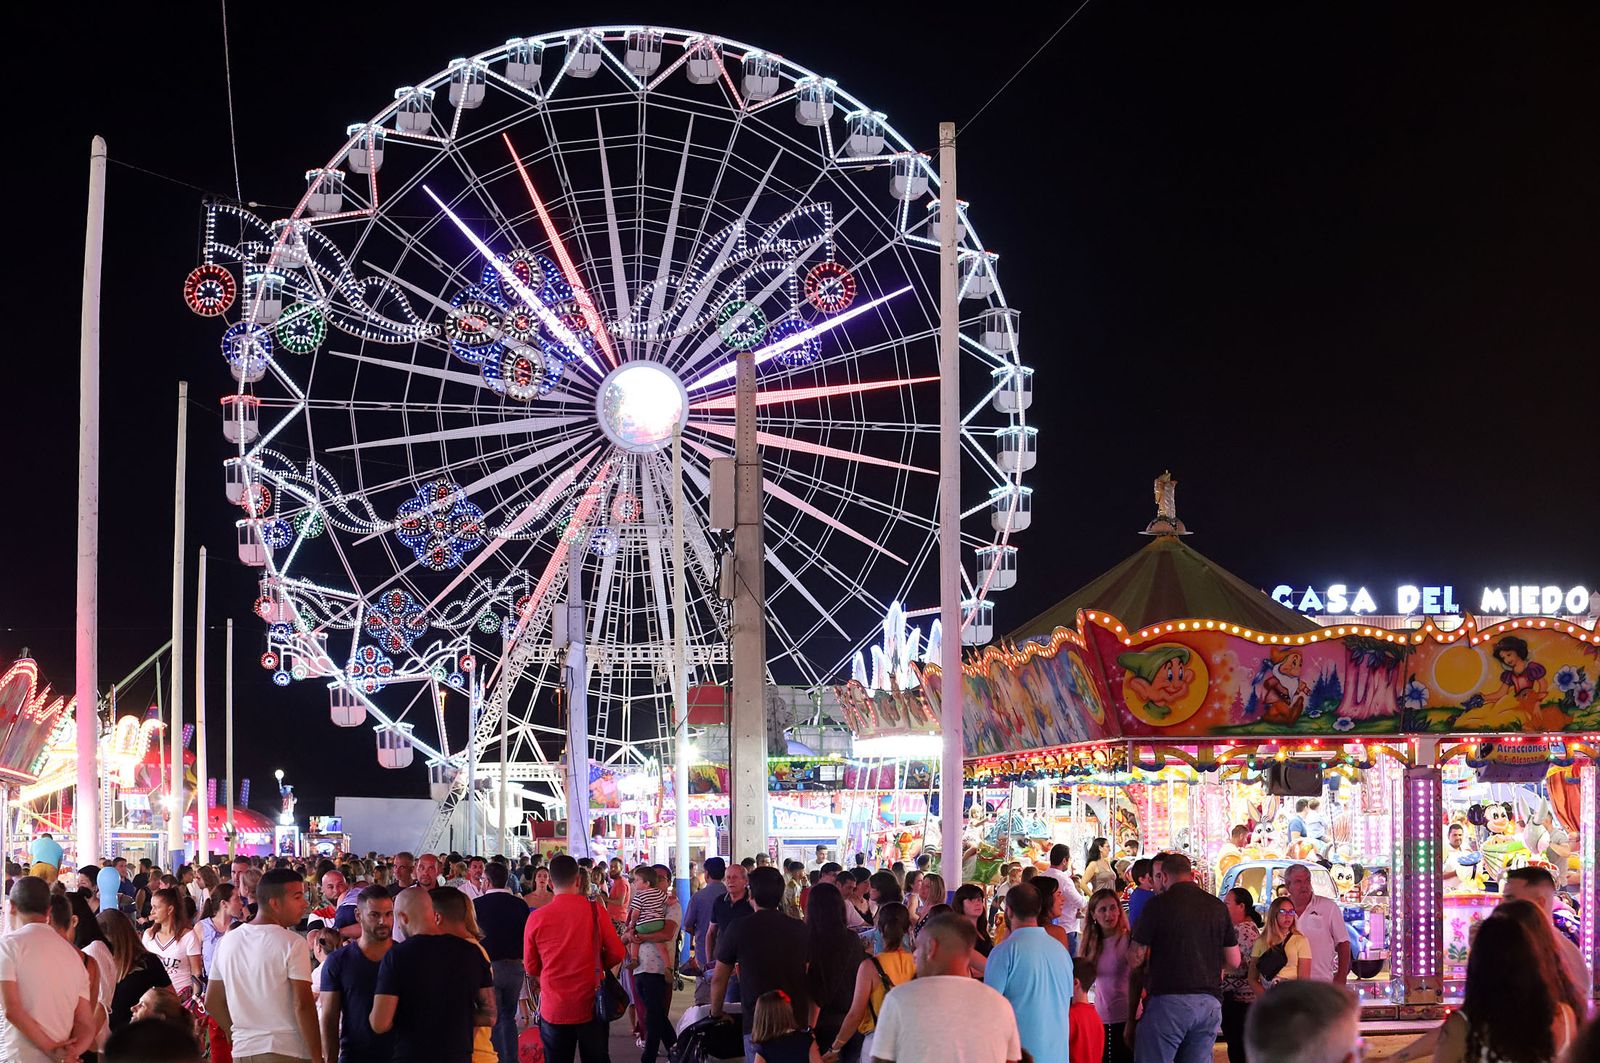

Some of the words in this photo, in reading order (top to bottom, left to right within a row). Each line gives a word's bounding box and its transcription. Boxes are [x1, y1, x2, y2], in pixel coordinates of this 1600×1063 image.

[1271, 585, 1377, 613] CASA
[1398, 585, 1459, 613] DEL
[1480, 585, 1589, 614] MIEDO
[1497, 743, 1547, 753] Atracciones
